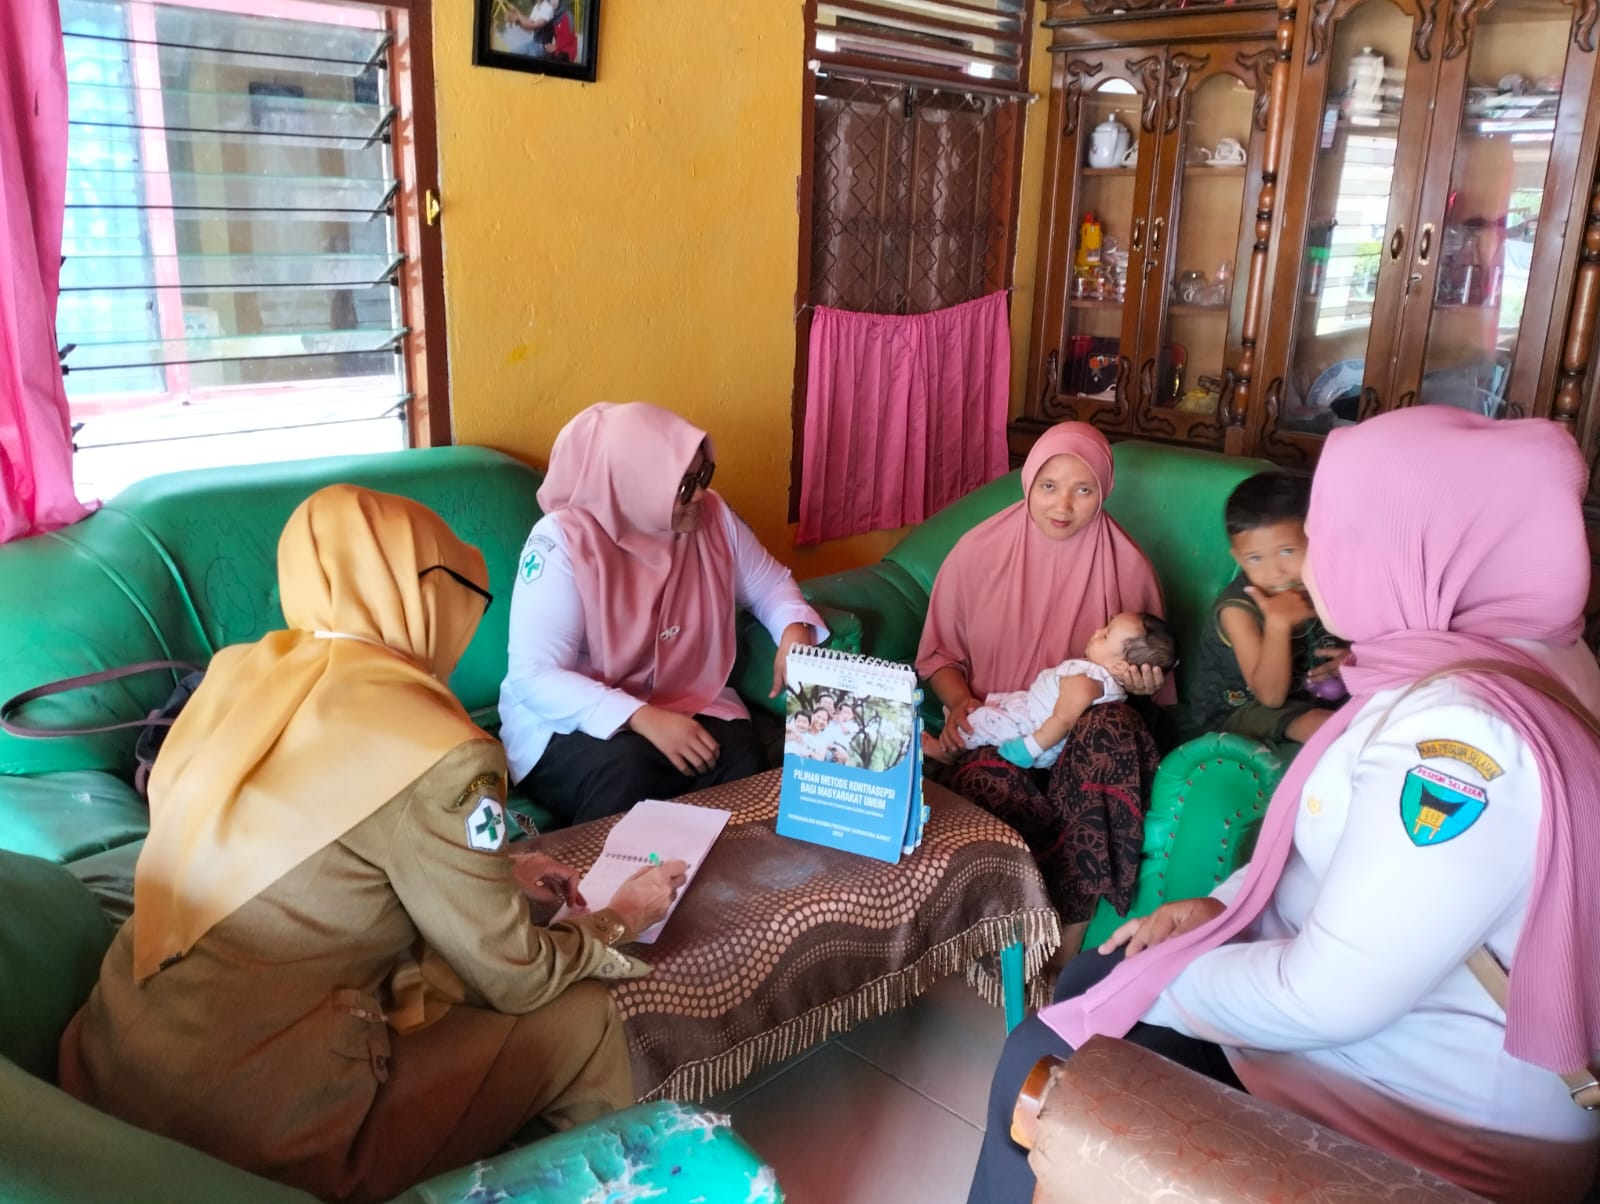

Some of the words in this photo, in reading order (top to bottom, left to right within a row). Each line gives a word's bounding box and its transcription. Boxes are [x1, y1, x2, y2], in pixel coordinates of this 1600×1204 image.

[793, 769, 821, 784] PILIHAN
[820, 775, 848, 790] METODE
[849, 781, 896, 800] KONTRASEPSI
[800, 782, 817, 795] BAGI
[818, 786, 863, 805] MASYARAKAT
[863, 796, 886, 810] UMUM
